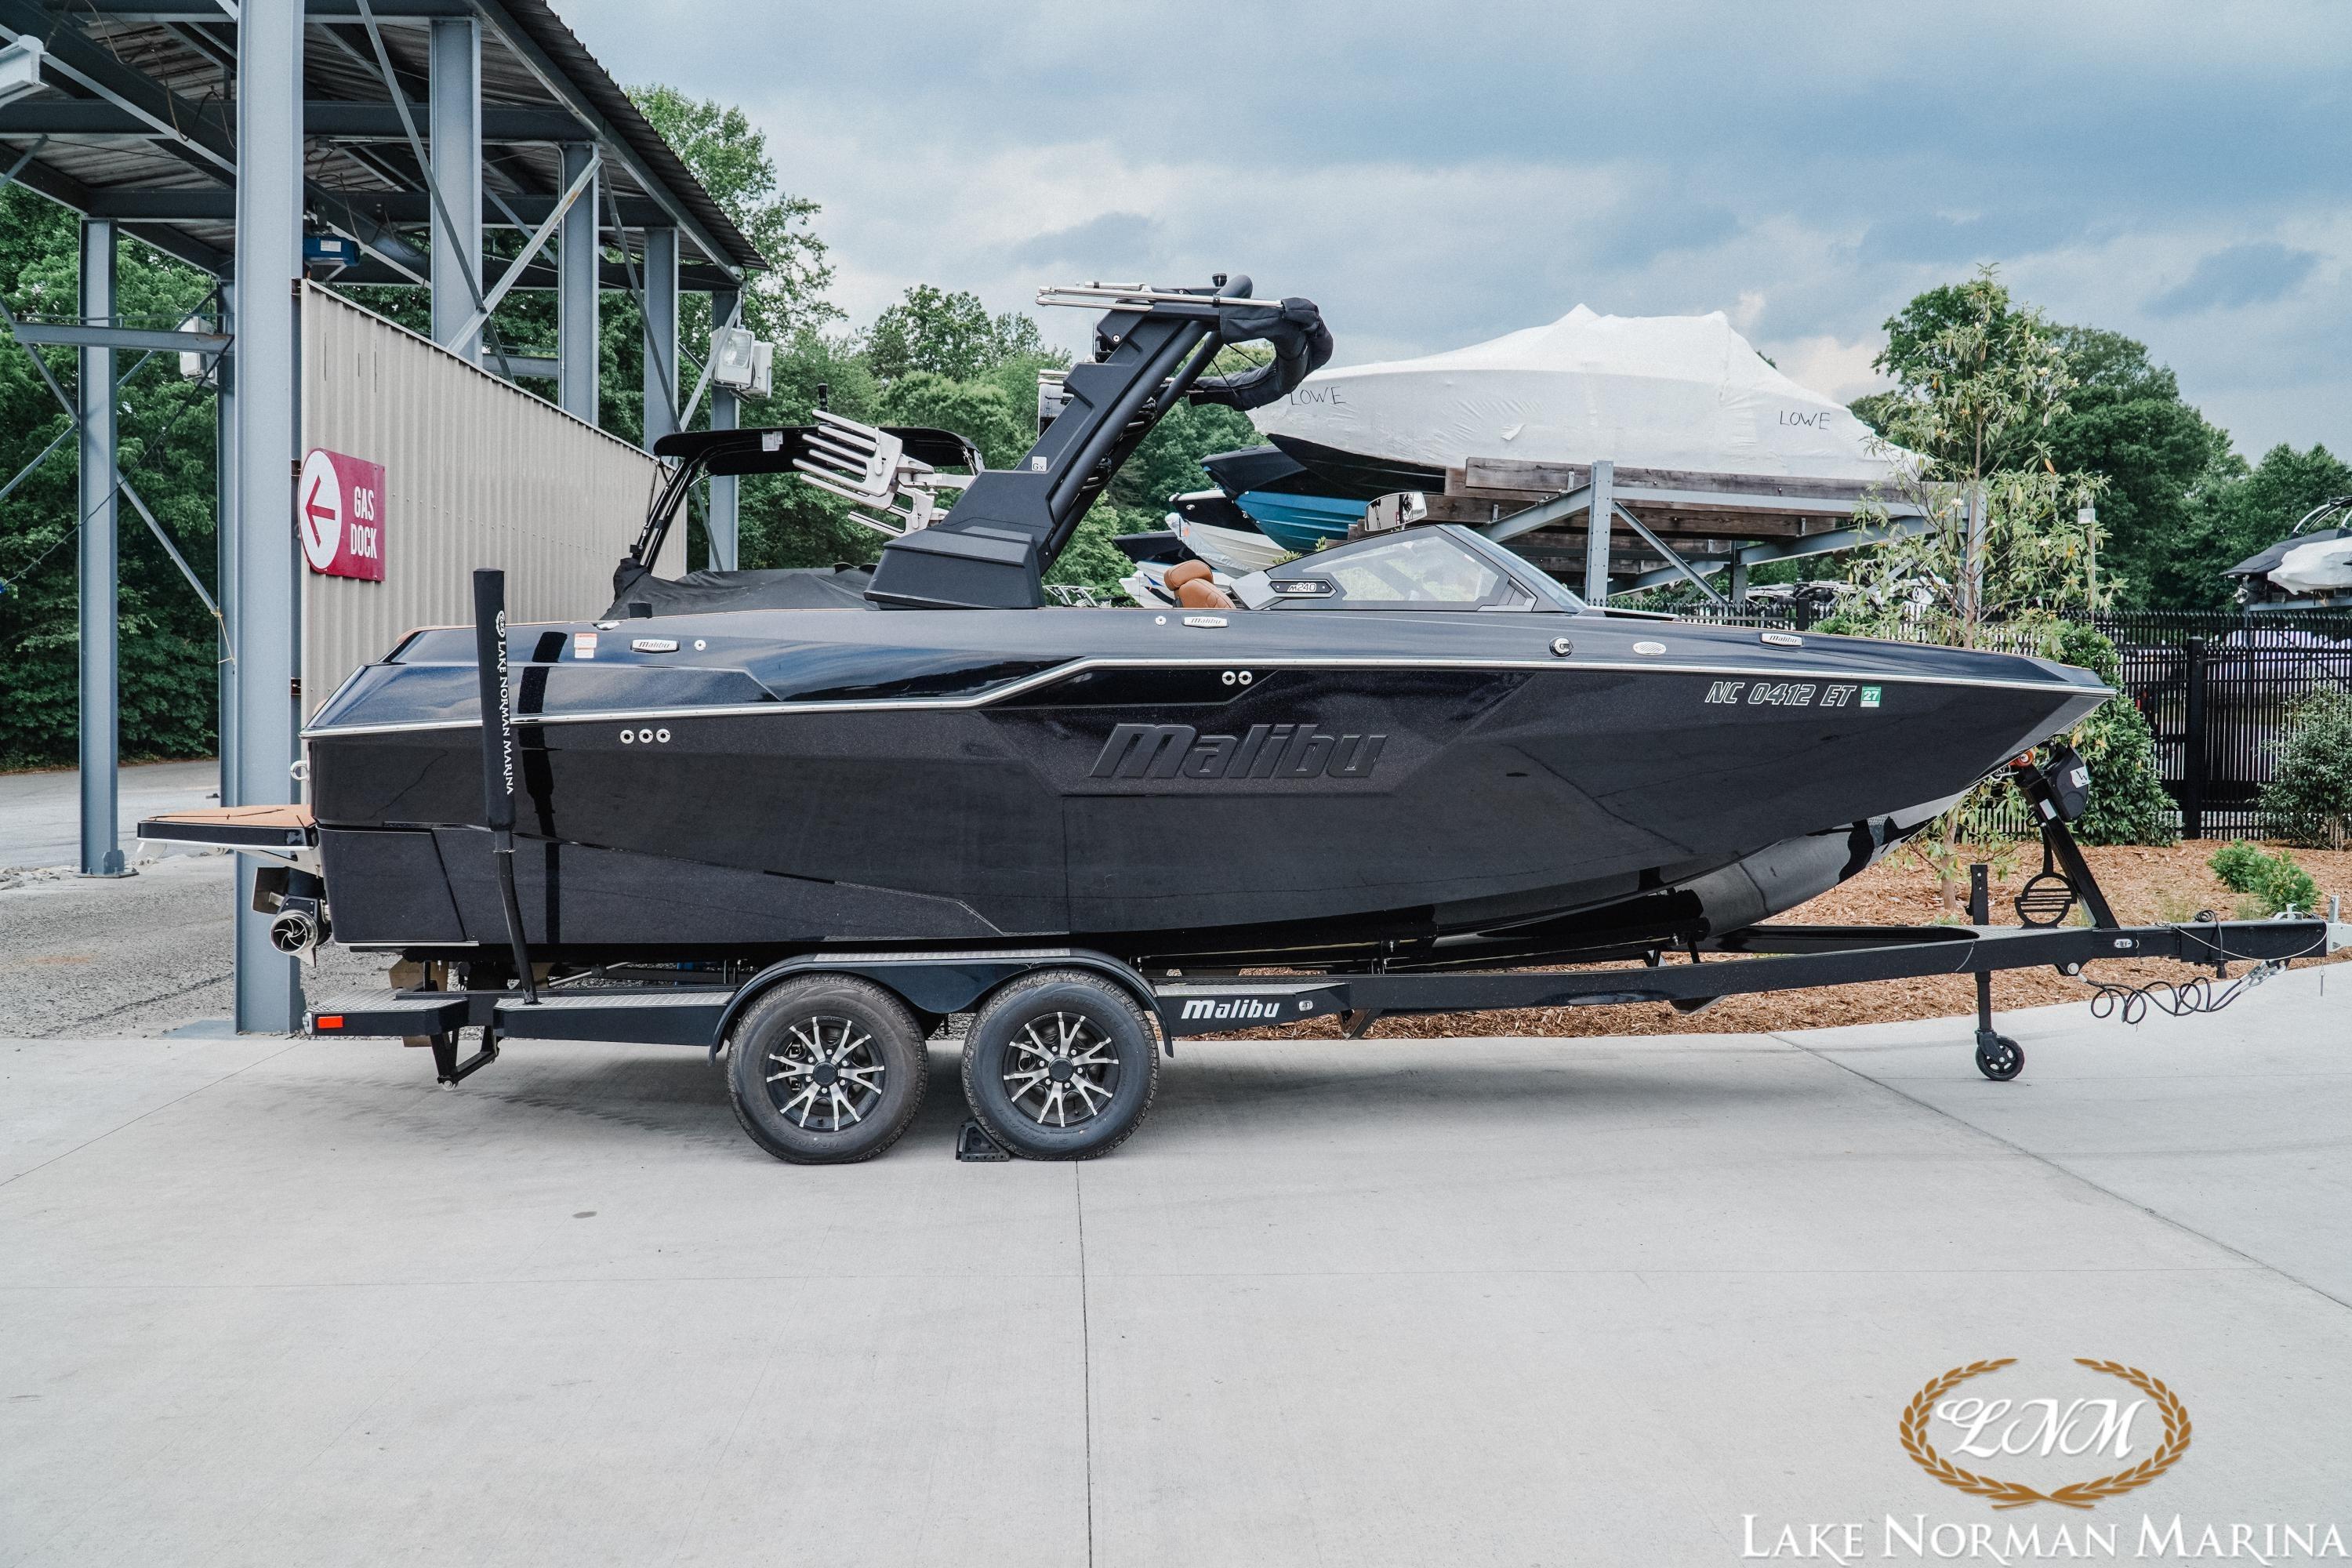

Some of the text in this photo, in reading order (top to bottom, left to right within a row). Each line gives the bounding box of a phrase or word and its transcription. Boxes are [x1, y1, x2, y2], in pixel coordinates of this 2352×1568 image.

[1290, 386, 1347, 406] LOWE
[1780, 410, 1831, 430] LOWE
[354, 485, 375, 521] GAS
[350, 523, 377, 559] DOCK
[497, 641, 507, 673] LAKE
[499, 676, 510, 737] NORMAN
[1704, 681, 1857, 706] NC 0412 ET
[1863, 690, 1879, 701] 27
[503, 739, 514, 795] MARINA
[1181, 999, 1280, 1019] Malibu
